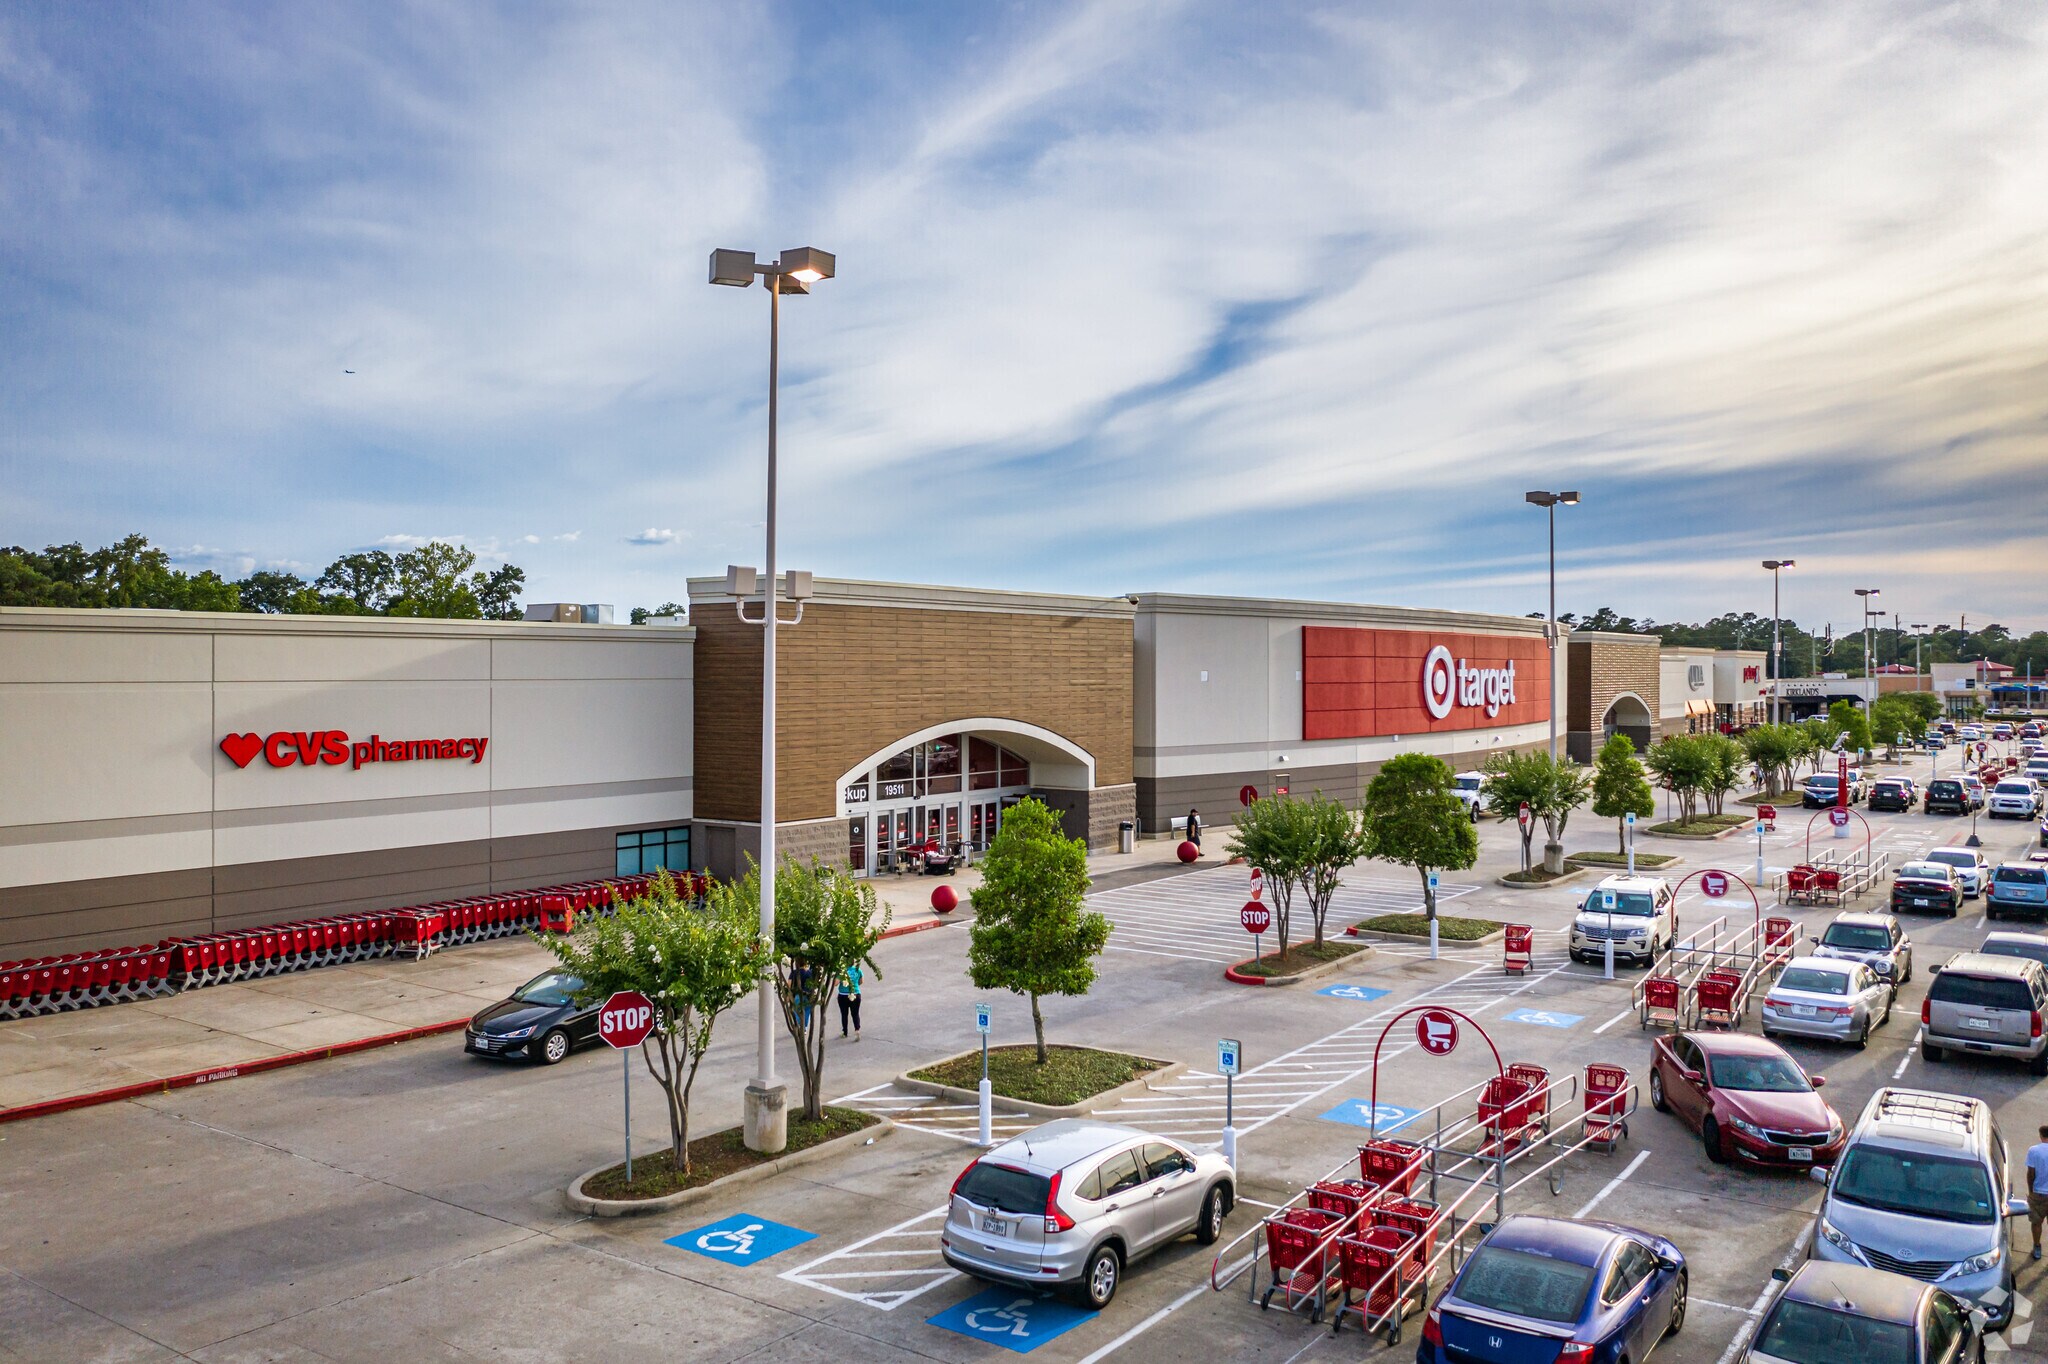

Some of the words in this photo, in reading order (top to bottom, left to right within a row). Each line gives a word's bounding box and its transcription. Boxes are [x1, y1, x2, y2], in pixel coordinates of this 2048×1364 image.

[1457, 658, 1516, 718] target
[264, 730, 350, 768] CVS
[352, 734, 489, 770] pharmacy
[884, 784, 905, 796] 19511
[1242, 911, 1269, 925] STOP
[603, 1006, 651, 1034] STOP
[195, 1075, 207, 1084] NO
[208, 1068, 238, 1081] PARKING
